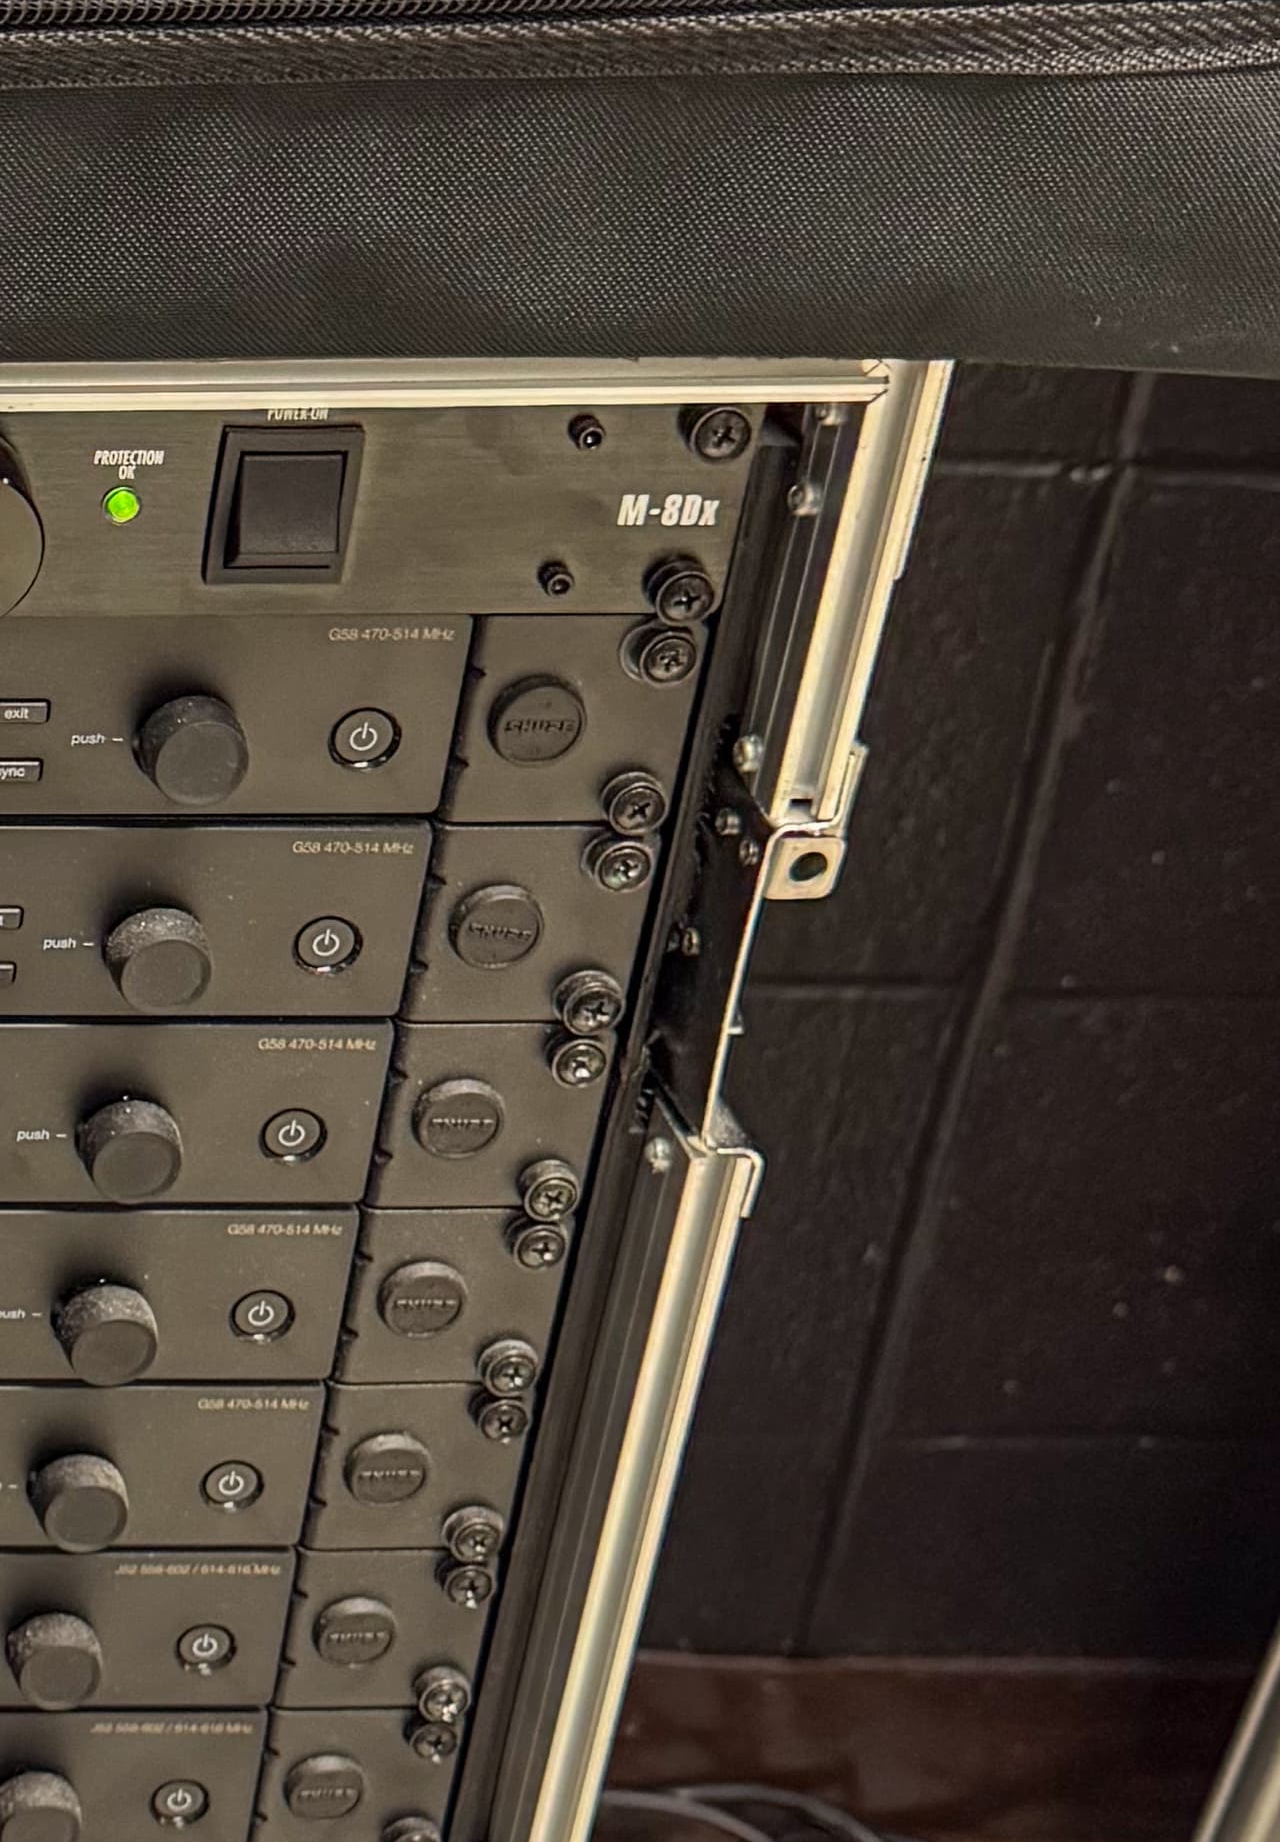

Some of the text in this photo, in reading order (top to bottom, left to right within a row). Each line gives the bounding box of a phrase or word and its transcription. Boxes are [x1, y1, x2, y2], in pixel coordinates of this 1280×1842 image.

[93, 450, 165, 466] PROTECTION
[117, 464, 136, 480] OK
[615, 493, 721, 527] M-8Dx
[423, 627, 455, 642] MHz
[4, 707, 29, 720] exit
[71, 731, 106, 747] push
